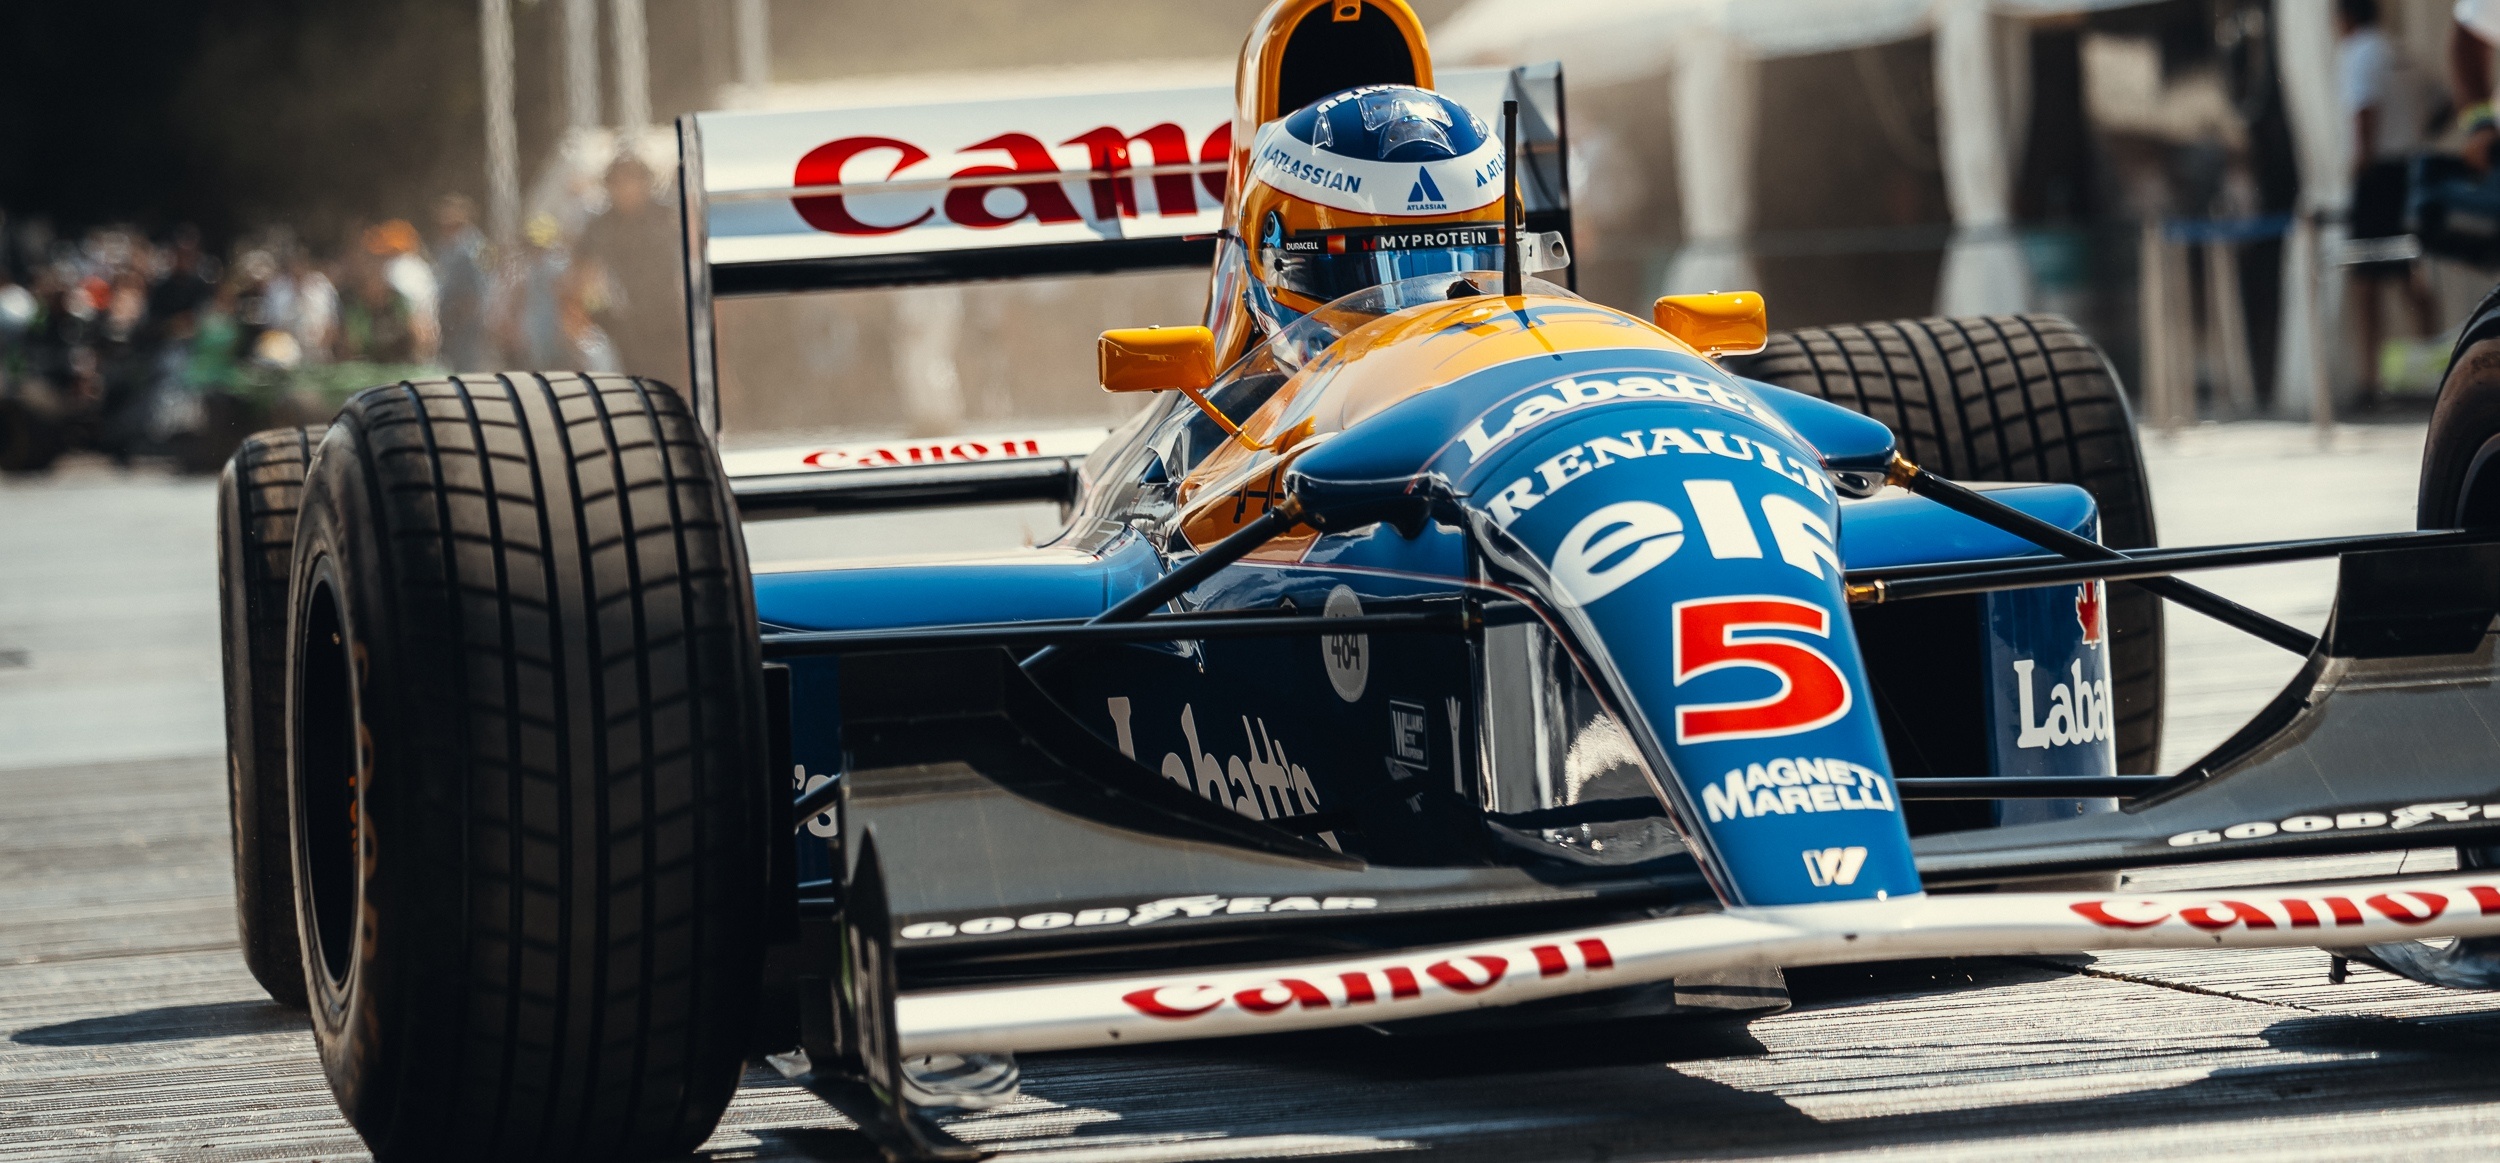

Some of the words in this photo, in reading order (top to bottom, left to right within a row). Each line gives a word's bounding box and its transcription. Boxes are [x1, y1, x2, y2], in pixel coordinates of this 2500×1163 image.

[1268, 149, 1362, 193] ATLASSIAN
[1406, 203, 1447, 211] ATLASSIAN
[1286, 241, 1319, 250] DURACELL
[1381, 231, 1487, 249] MYPROTEIN
[803, 440, 1042, 470] Canon
[1484, 427, 1832, 533] RENAULT
[1551, 479, 1841, 608] elf
[1672, 594, 1853, 746] 5
[1702, 757, 1894, 806] MAGNETI
[1702, 780, 1894, 823] MARELLI
[900, 895, 1379, 940] GOODYEAR
[1122, 937, 1613, 1019] Canon
